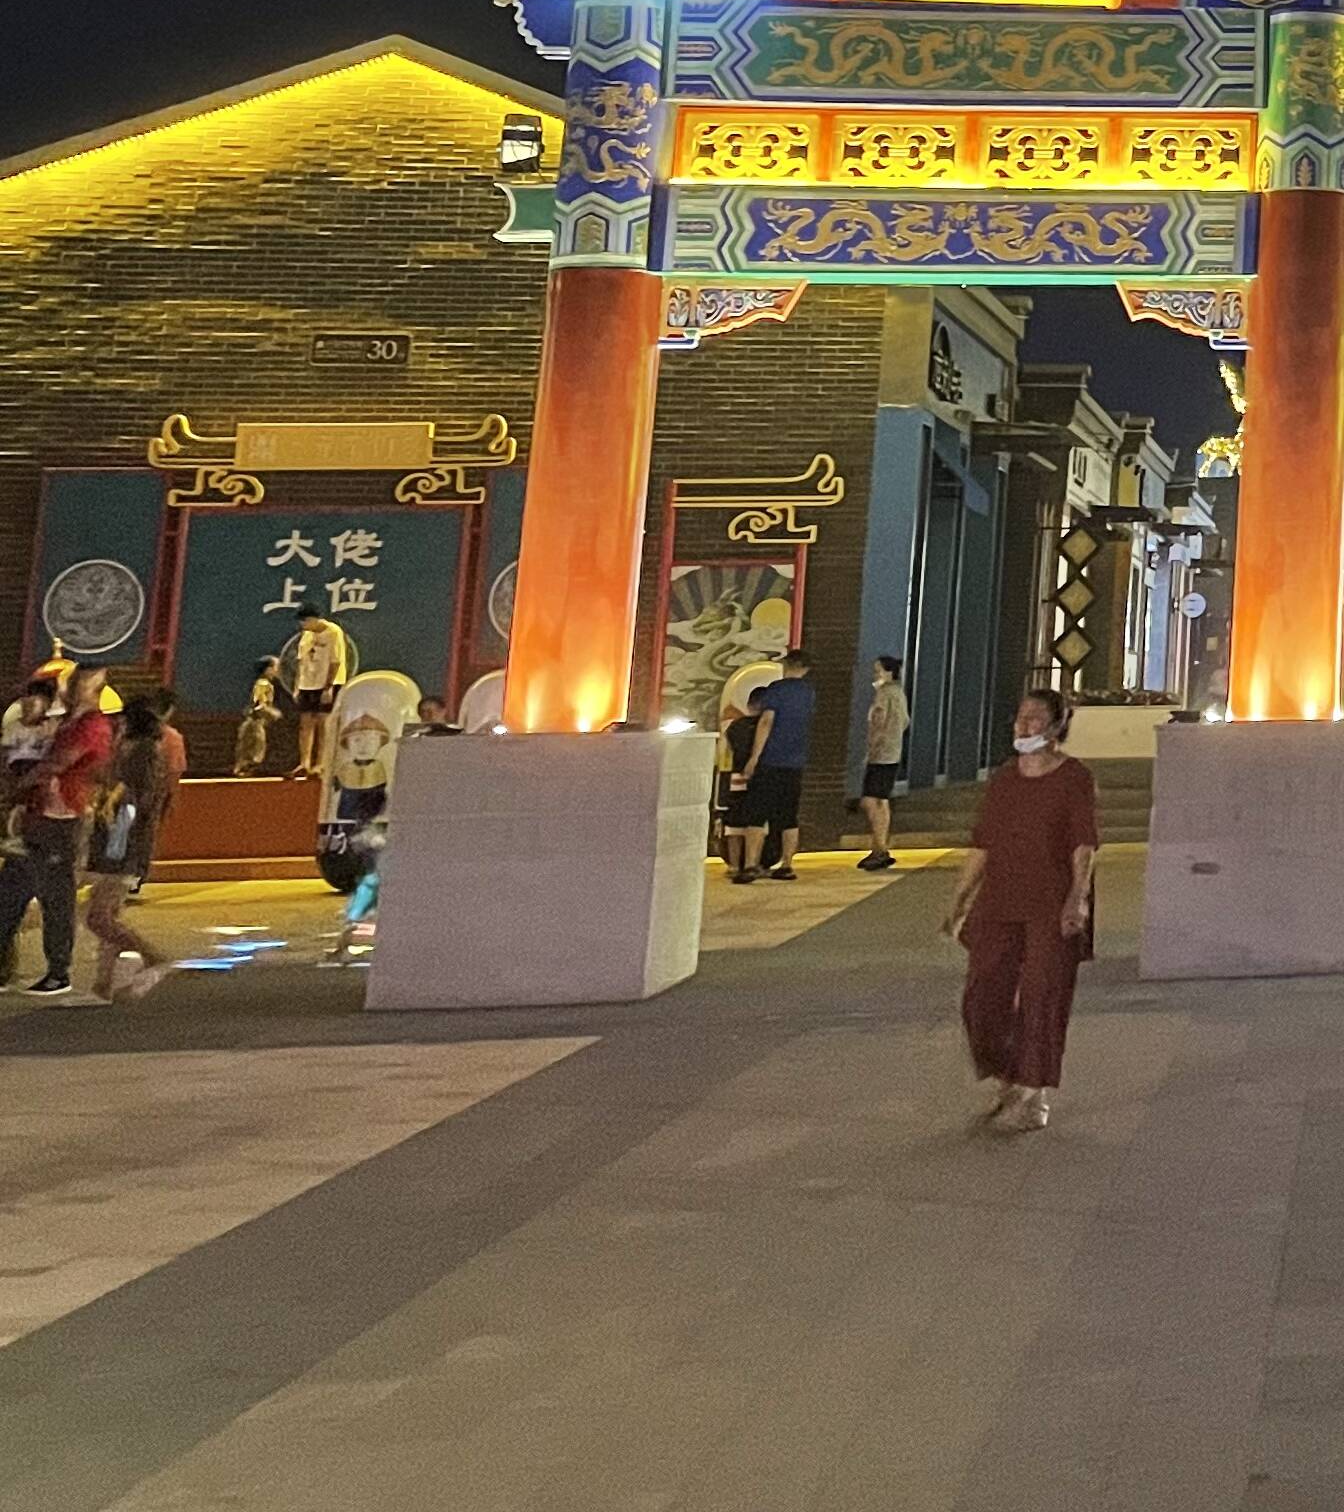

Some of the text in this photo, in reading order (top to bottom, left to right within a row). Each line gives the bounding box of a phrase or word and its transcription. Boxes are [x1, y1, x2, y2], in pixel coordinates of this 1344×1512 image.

[366, 340, 398, 360] 30
[266, 529, 385, 568] 大佬
[262, 577, 378, 613] 上位
